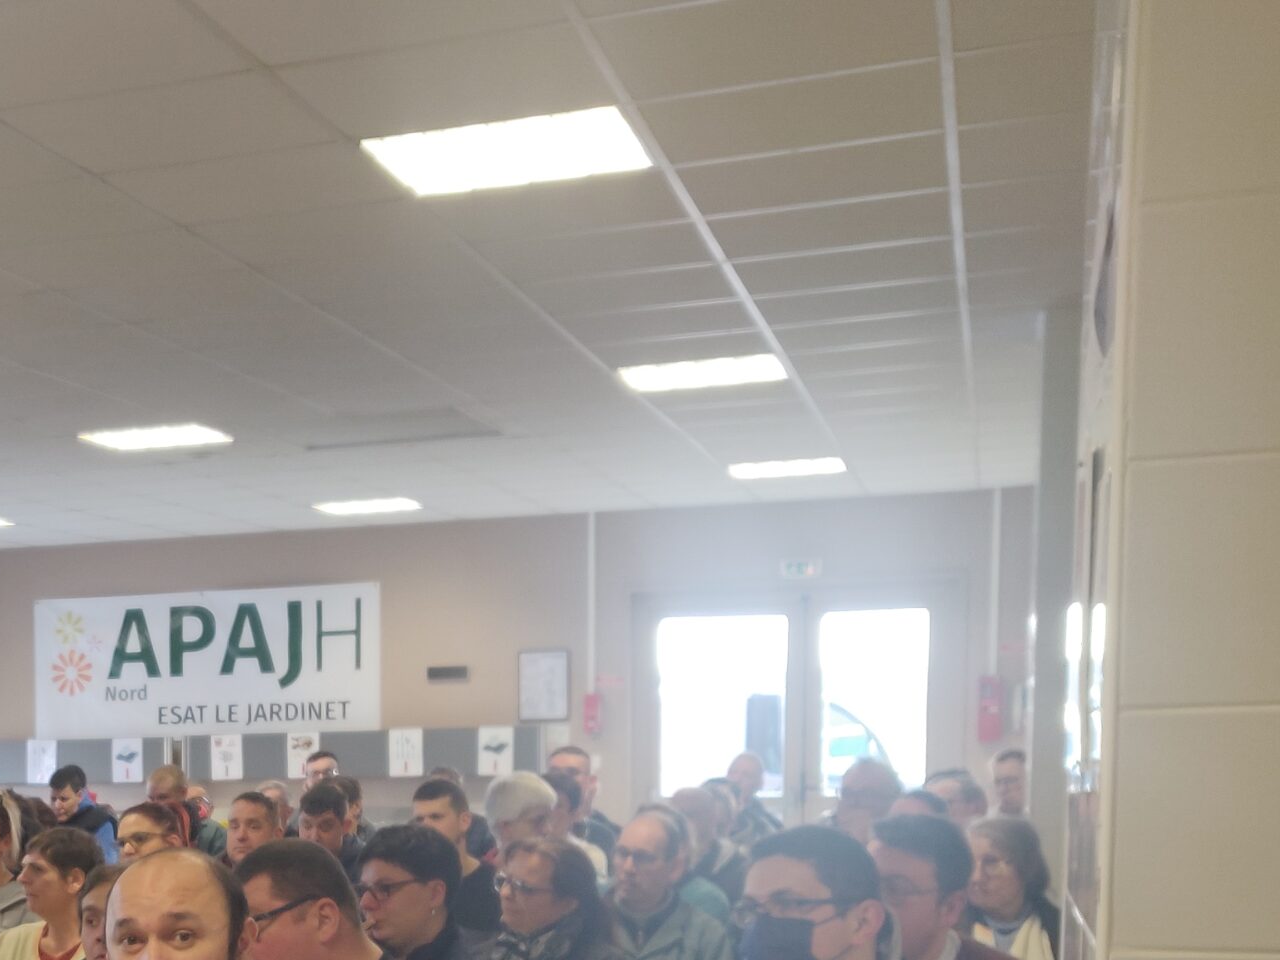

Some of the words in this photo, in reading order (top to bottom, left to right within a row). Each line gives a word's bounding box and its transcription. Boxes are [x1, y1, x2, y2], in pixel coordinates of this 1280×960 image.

[108, 598, 361, 690] APAJH
[105, 684, 147, 701] Nord
[158, 706, 207, 725] ESAT
[216, 704, 239, 723] LE
[246, 701, 351, 726] JARDINET
